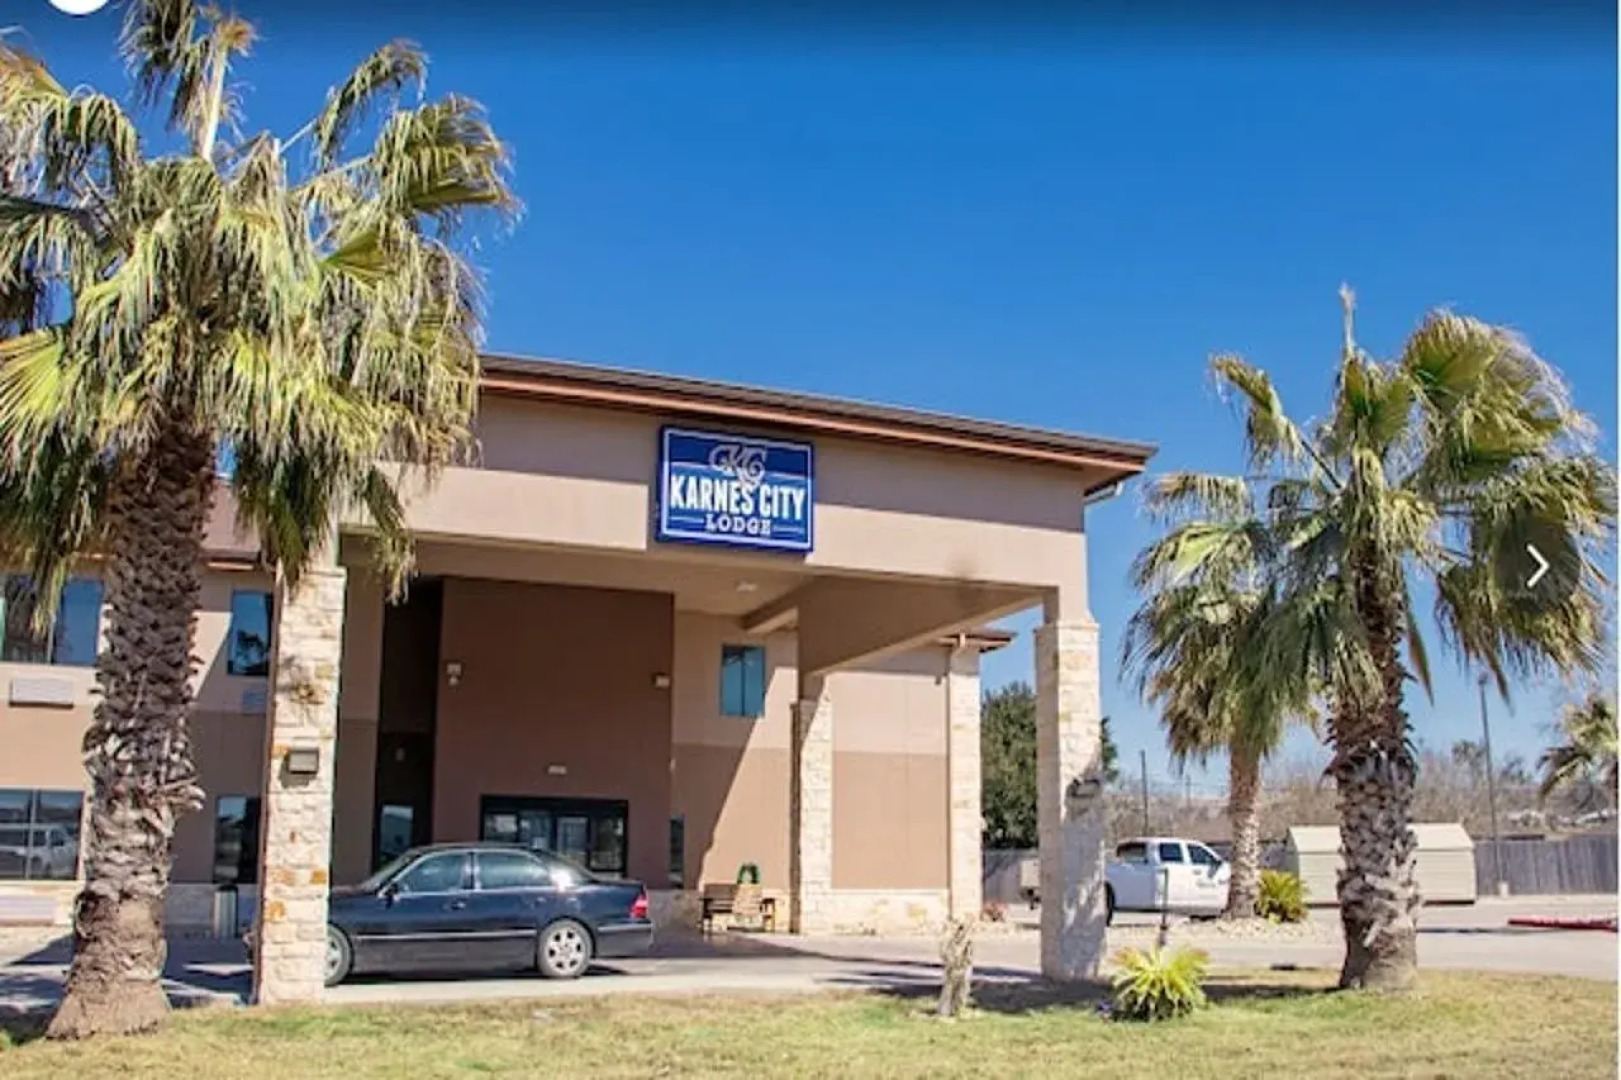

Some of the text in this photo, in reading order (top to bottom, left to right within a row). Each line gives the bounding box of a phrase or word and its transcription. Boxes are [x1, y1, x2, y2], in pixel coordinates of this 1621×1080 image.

[670, 474, 806, 520] KARNES CITY
[705, 513, 771, 535] LODGE
